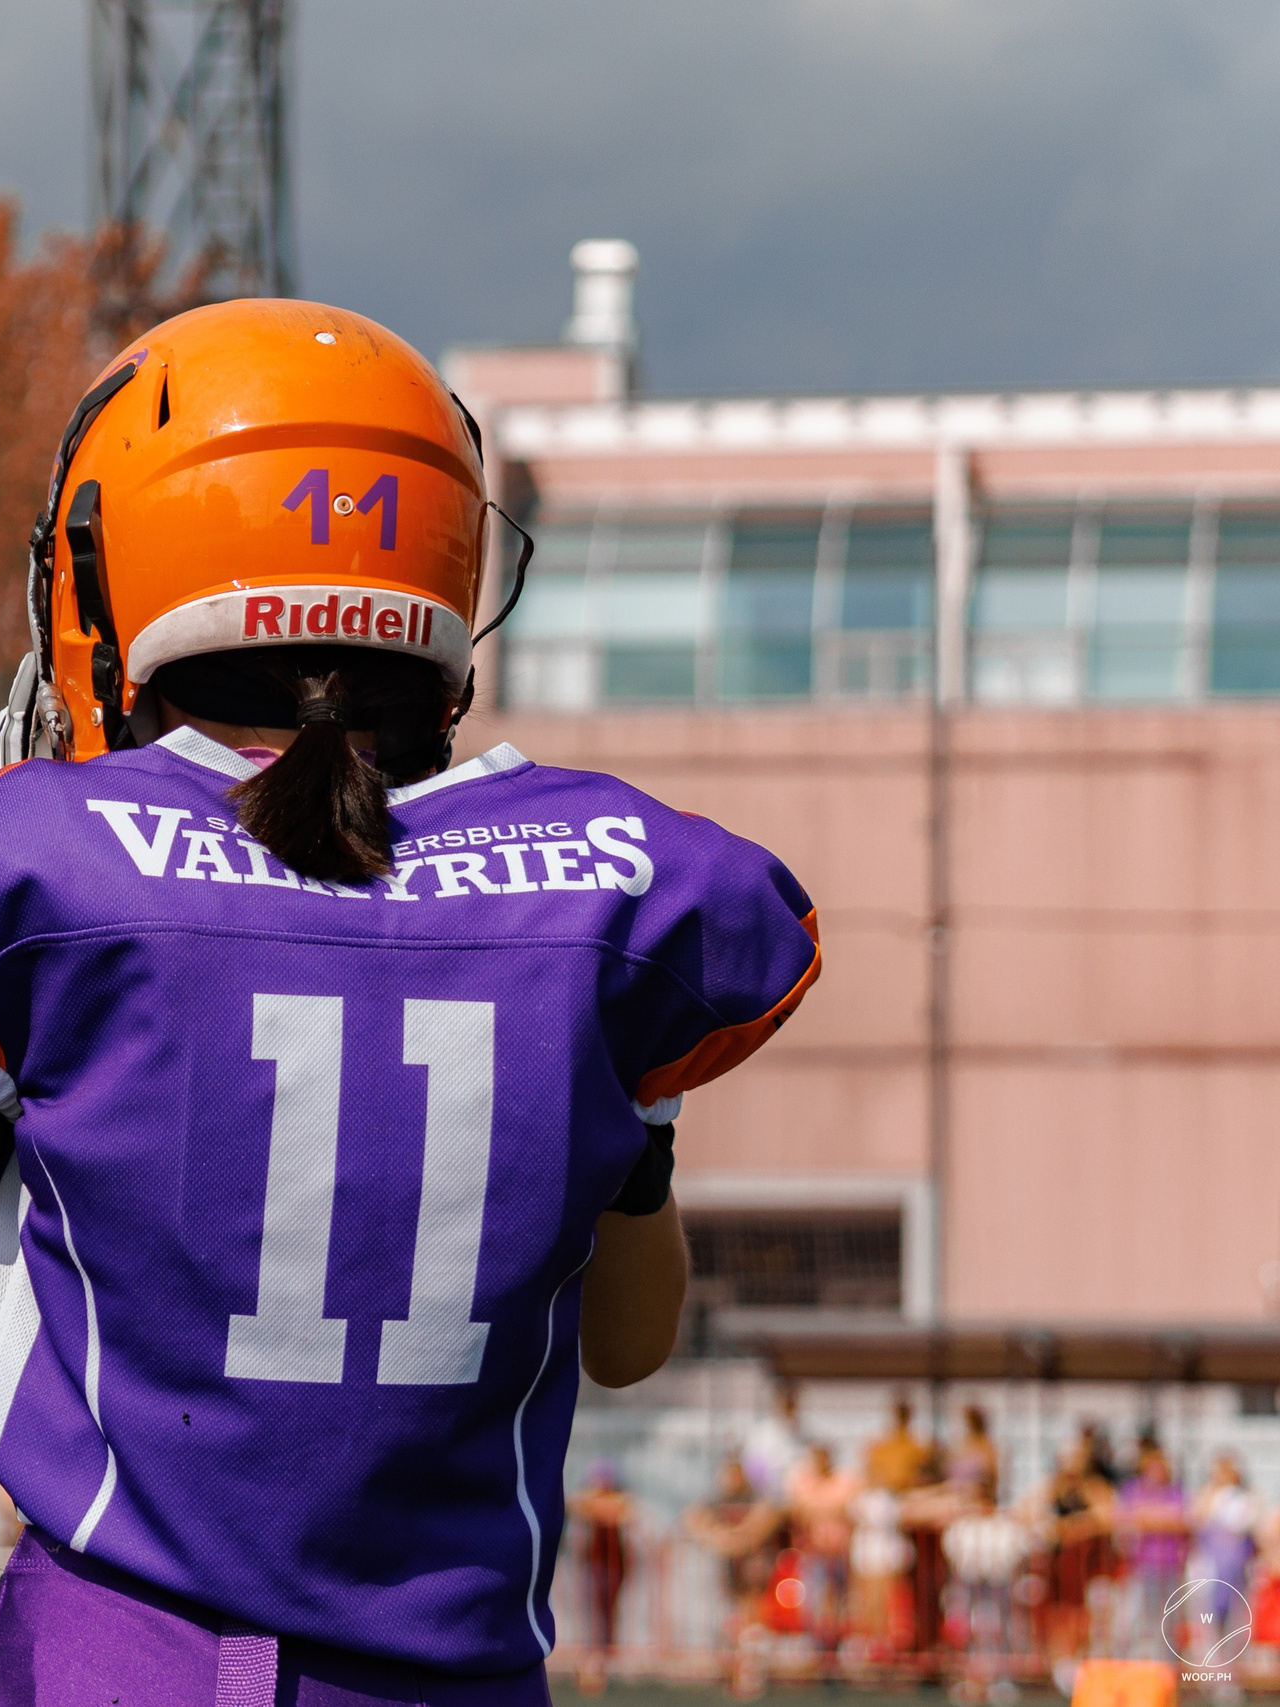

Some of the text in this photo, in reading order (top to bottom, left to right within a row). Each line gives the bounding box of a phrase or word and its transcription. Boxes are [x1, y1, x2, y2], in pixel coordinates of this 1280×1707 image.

[280, 468, 399, 551] 11
[242, 592, 434, 647] Riddell
[391, 820, 574, 858] ERSBURG
[224, 993, 495, 1386] 11
